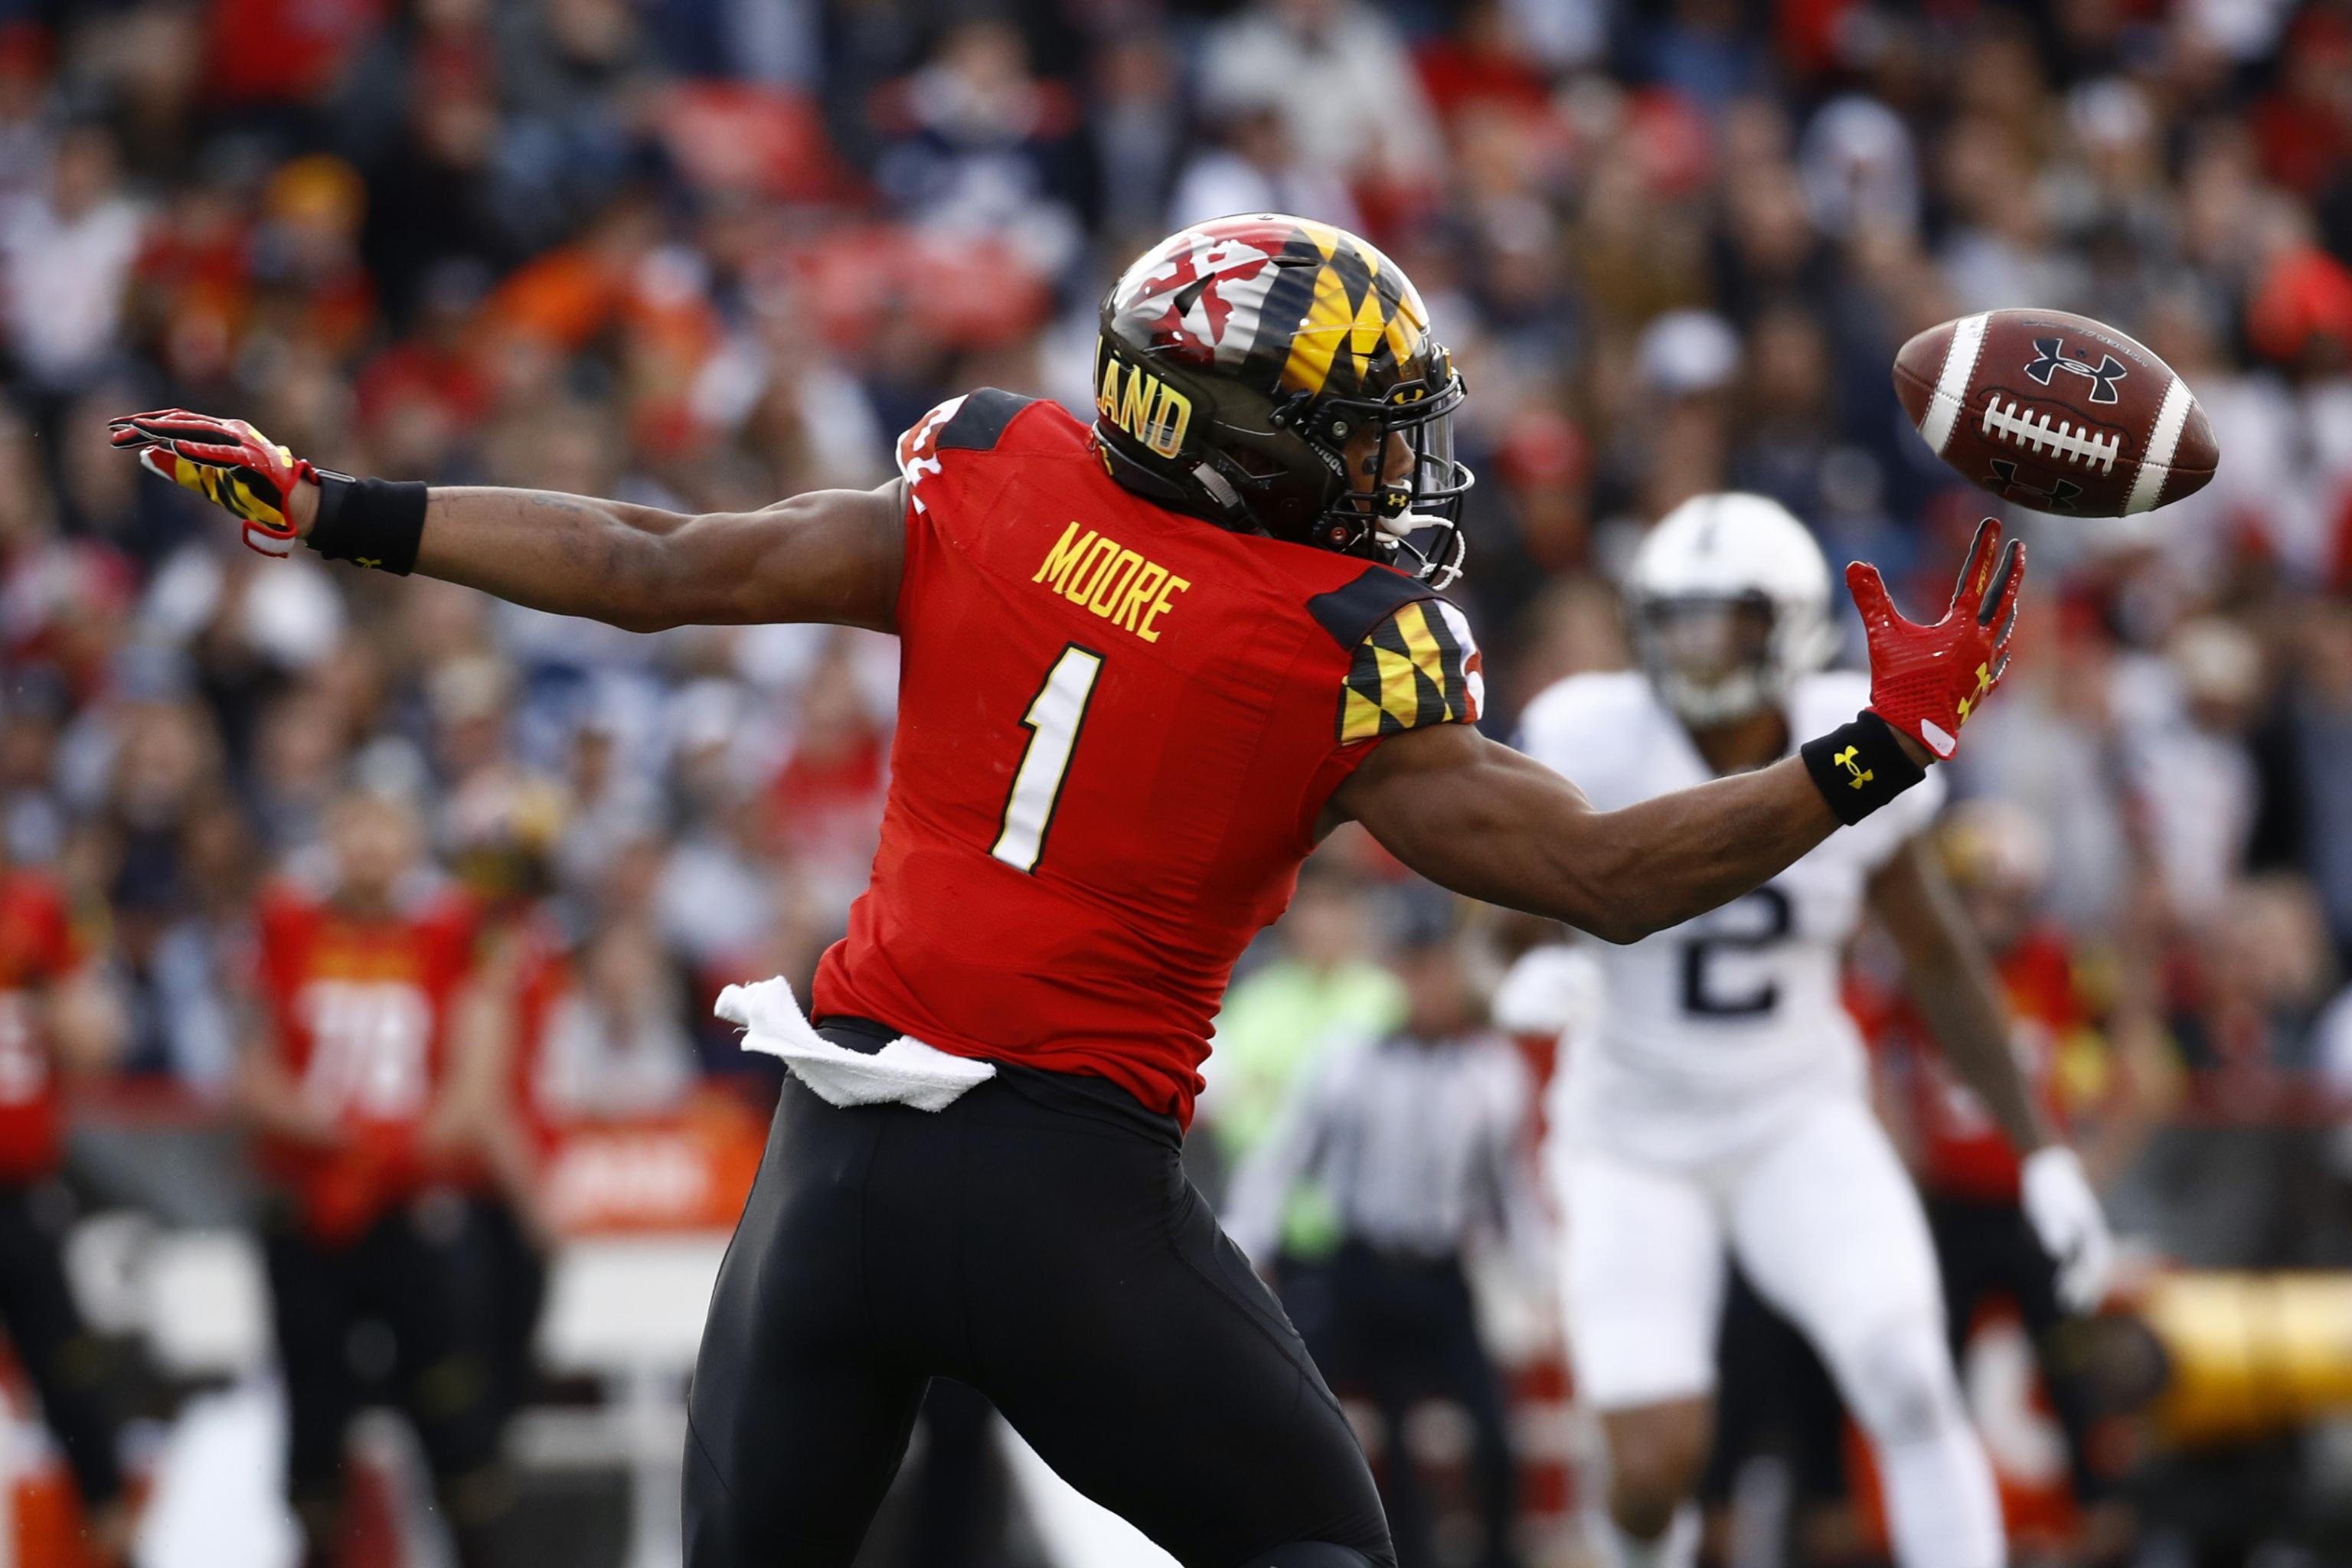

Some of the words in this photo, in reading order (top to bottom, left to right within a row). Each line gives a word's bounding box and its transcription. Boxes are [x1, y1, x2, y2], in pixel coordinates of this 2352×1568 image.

[1031, 521, 1191, 644] MOORE
[987, 641, 1107, 877] 1
[1679, 884, 1793, 1018] 2
